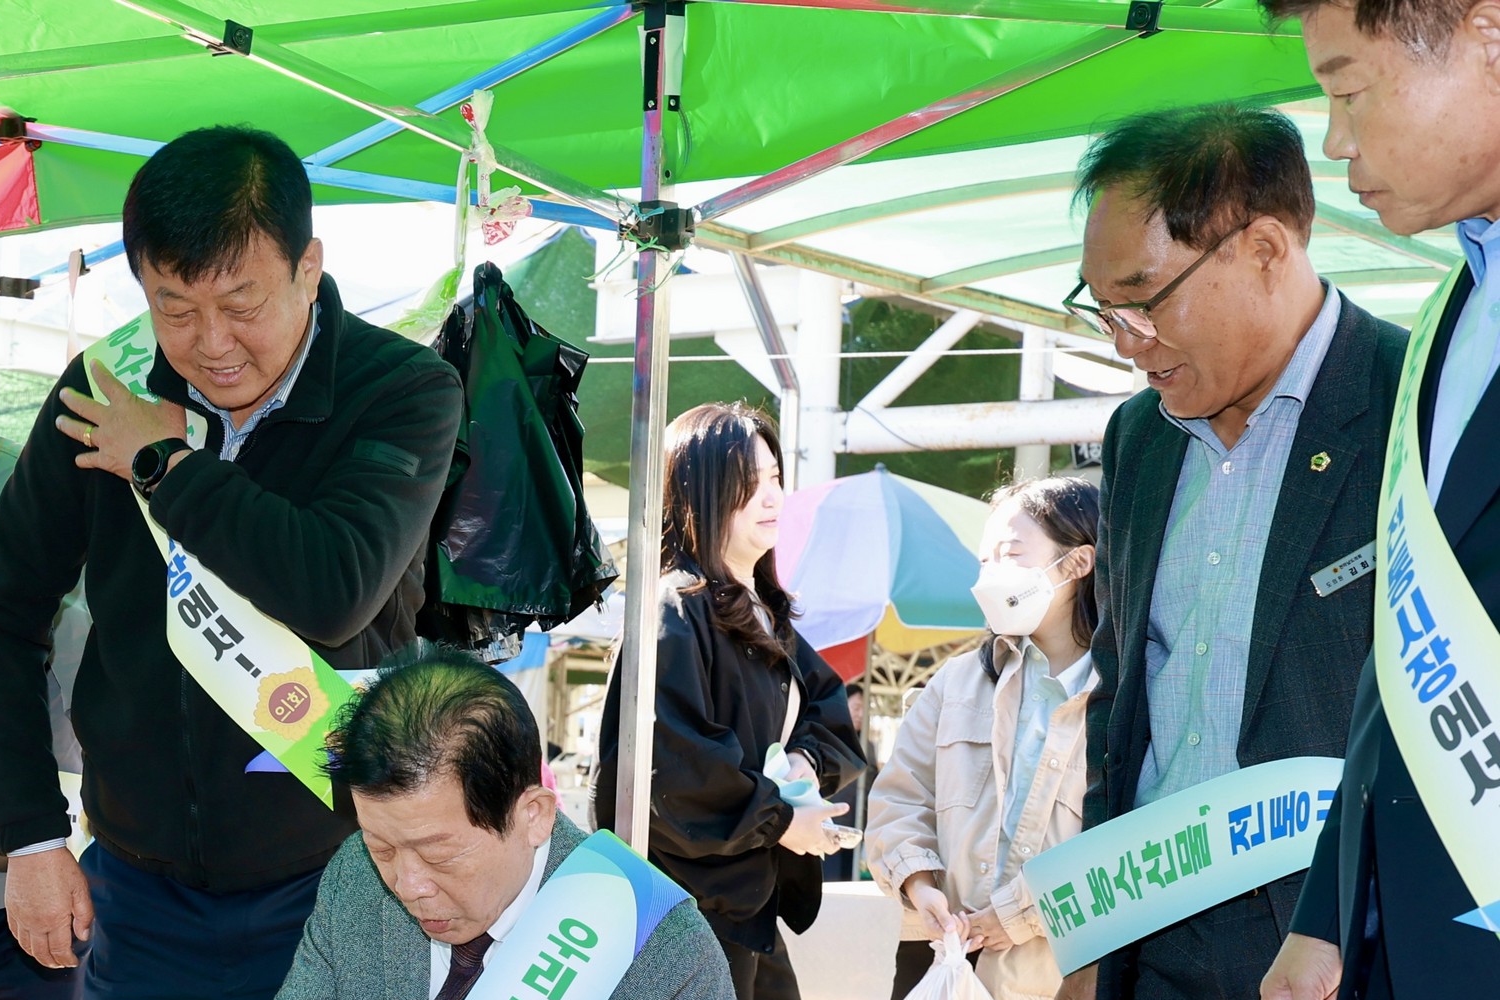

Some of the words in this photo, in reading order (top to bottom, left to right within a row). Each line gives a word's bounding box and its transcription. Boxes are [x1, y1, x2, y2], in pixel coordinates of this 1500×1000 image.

[166, 537, 263, 679] 장에서!
[274, 684, 310, 723] 의회
[1038, 880, 1086, 940] 우리
[1085, 804, 1213, 918] 농수산물,
